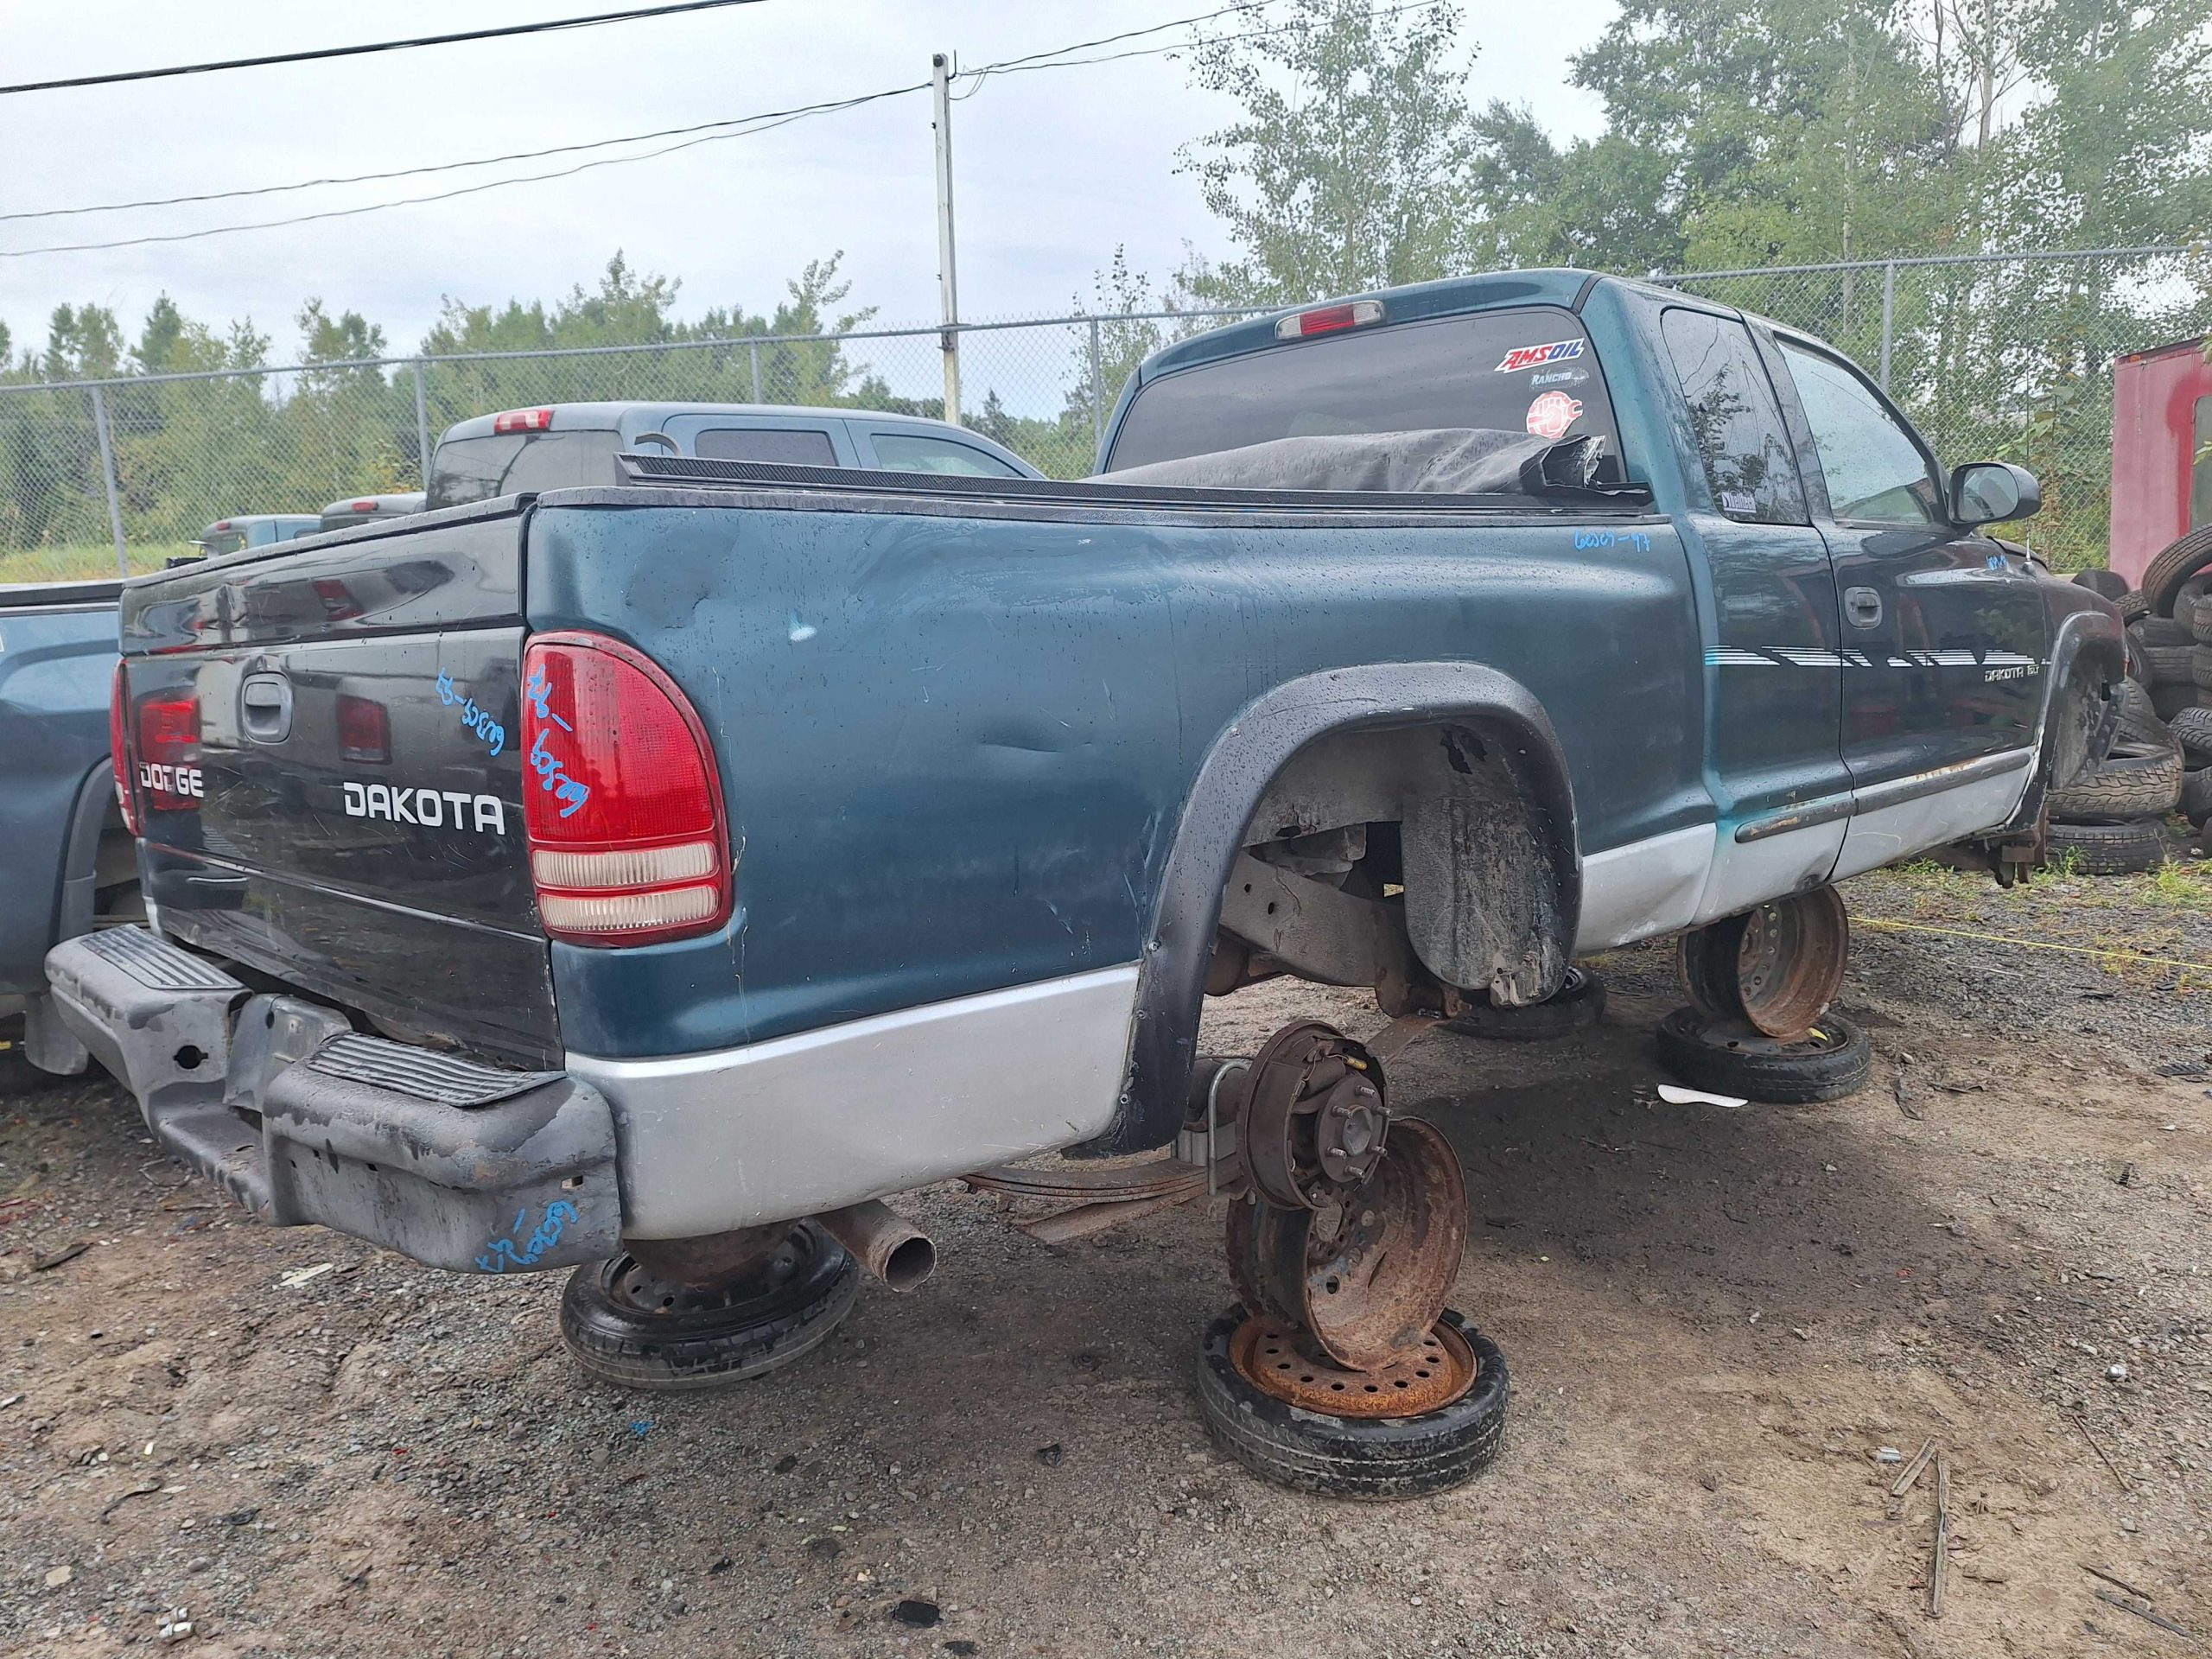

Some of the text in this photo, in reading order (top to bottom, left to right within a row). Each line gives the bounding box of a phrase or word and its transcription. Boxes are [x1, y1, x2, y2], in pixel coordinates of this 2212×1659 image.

[1501, 340, 1583, 371] AMSOIL
[1531, 371, 1573, 385] RANCHO
[1985, 666, 2024, 683] DAKOTA
[343, 781, 505, 836] DAKOTA
